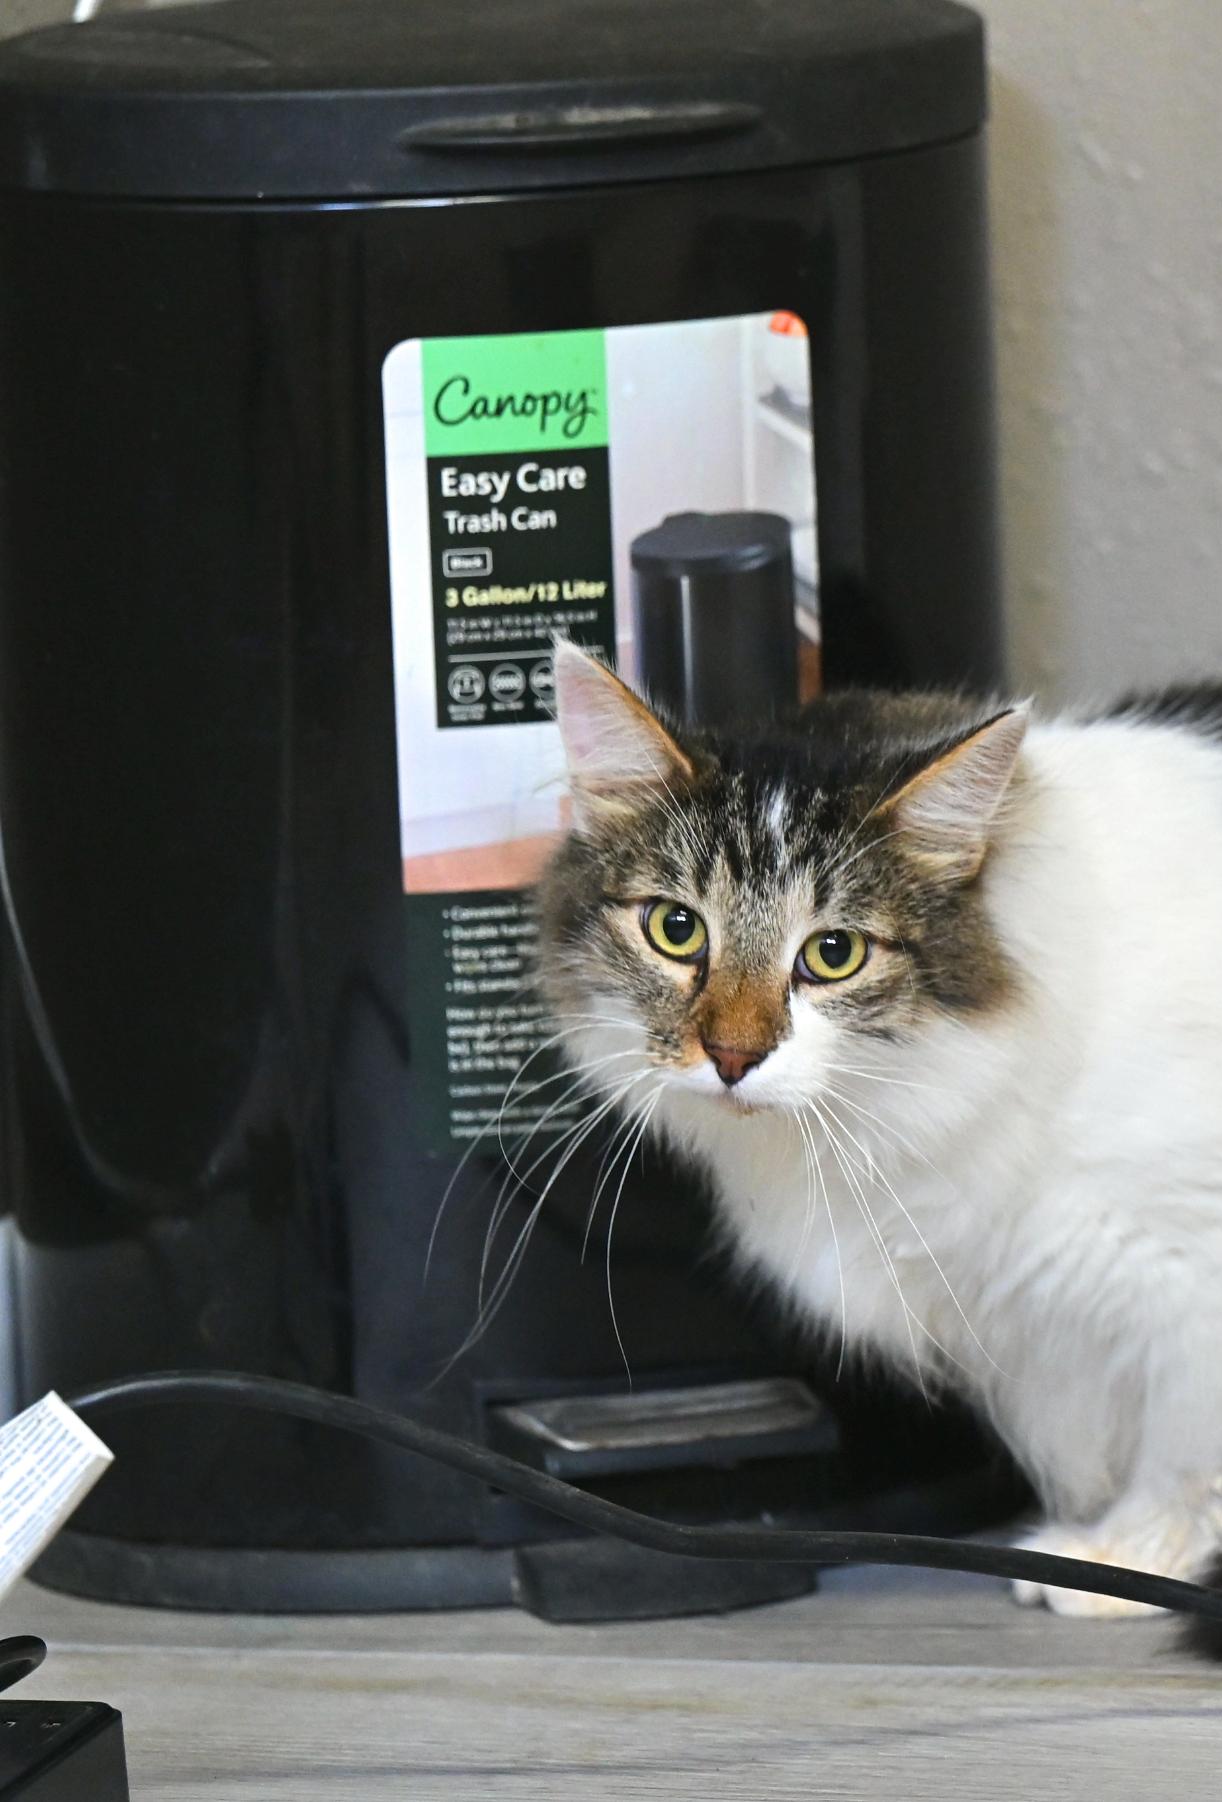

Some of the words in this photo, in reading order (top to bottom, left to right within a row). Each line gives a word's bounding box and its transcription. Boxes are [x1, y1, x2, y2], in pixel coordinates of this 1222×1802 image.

[434, 375, 598, 439] Canopy
[440, 466, 512, 504] Easy
[516, 462, 588, 493] Care
[443, 508, 508, 534] Trash
[511, 506, 558, 531] Can
[445, 587, 460, 608] 3
[462, 581, 559, 607] Gallon/12
[561, 579, 608, 600] Liter
